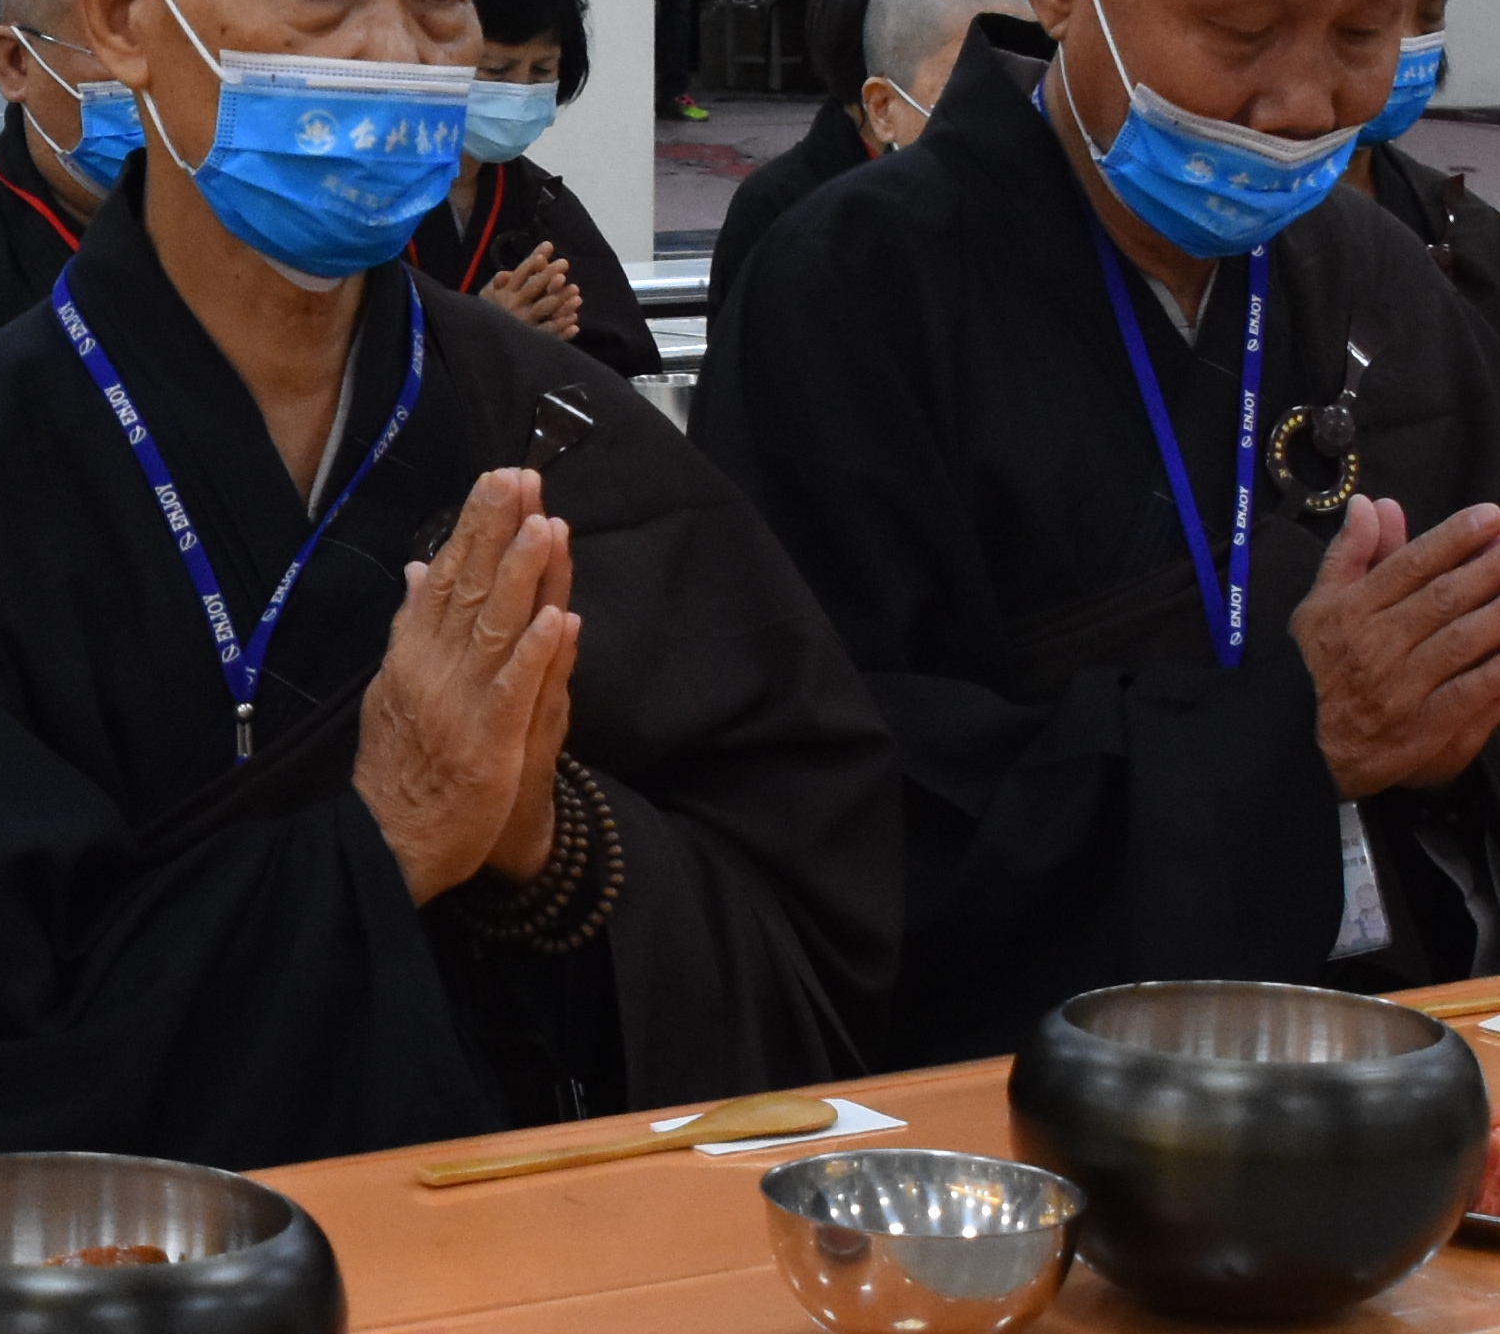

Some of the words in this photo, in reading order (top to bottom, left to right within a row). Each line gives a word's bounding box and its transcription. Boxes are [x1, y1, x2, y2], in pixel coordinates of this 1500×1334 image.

[58, 301, 87, 340] ENJOY
[1249, 294, 1263, 336] ENJOY
[104, 384, 139, 426] ENJOY
[1244, 390, 1256, 432] ENJOY
[155, 483, 190, 532] ENJOY
[1236, 485, 1250, 529] ENJOY
[271, 561, 301, 604] ENJOY
[202, 592, 235, 642] ENJOY
[1230, 584, 1244, 629] ENJOY
